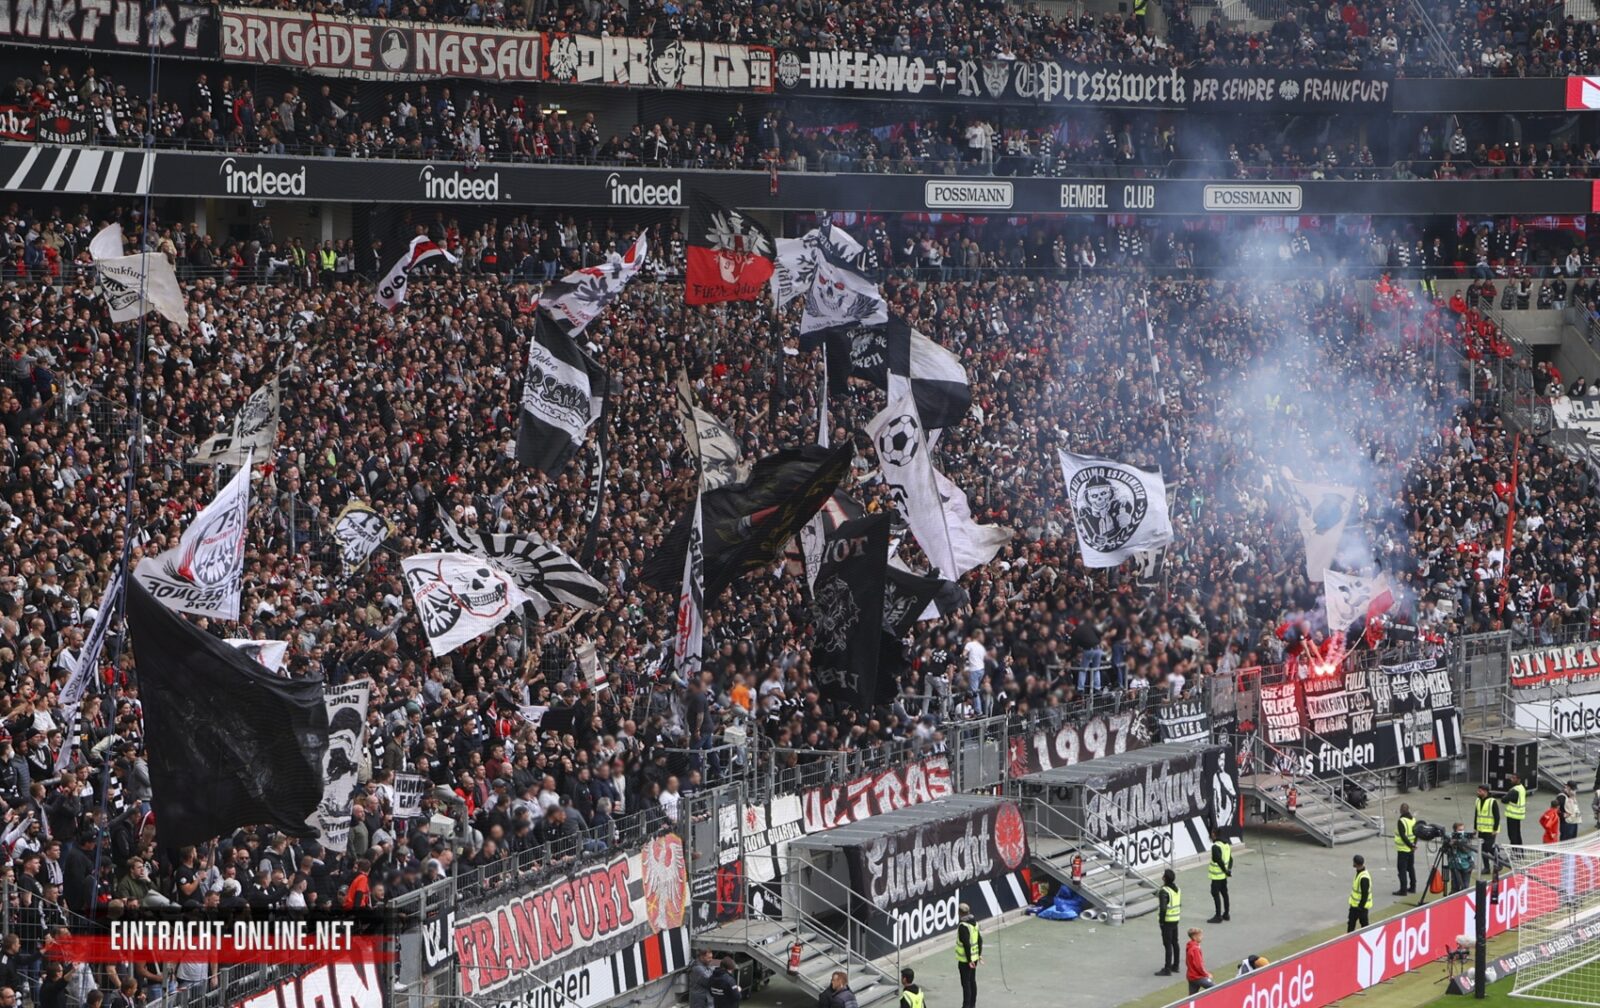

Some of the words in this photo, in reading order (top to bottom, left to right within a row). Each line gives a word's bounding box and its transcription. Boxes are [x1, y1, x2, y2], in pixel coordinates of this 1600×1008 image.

[222, 15, 372, 67] BRIGADE
[416, 32, 539, 80] NASSAU
[809, 50, 925, 93] INFERNO
[1038, 61, 1187, 102] Presswerk
[1192, 80, 1219, 102] PER
[1222, 77, 1275, 102] SEMPRE
[1304, 77, 1389, 102] FRANKFURT
[219, 157, 306, 196] indeed
[419, 164, 499, 200] indeed
[606, 172, 682, 206] indeed
[934, 187, 1006, 203] POSSMANN
[1060, 184, 1109, 208] BEMBEL
[1124, 185, 1155, 208] CLUB
[1213, 190, 1293, 205] POSSMANN
[1160, 702, 1202, 720] ULTRAS
[1167, 721, 1203, 738] NEVER
[1034, 711, 1133, 771] 1997
[1318, 740, 1375, 773] finden
[803, 755, 952, 834] ULTRAS
[868, 815, 994, 910] Eintracht
[887, 888, 960, 946] indeed
[1496, 876, 1528, 930] dpd
[455, 857, 636, 997] FRANKFURT
[1392, 908, 1430, 973] dpd
